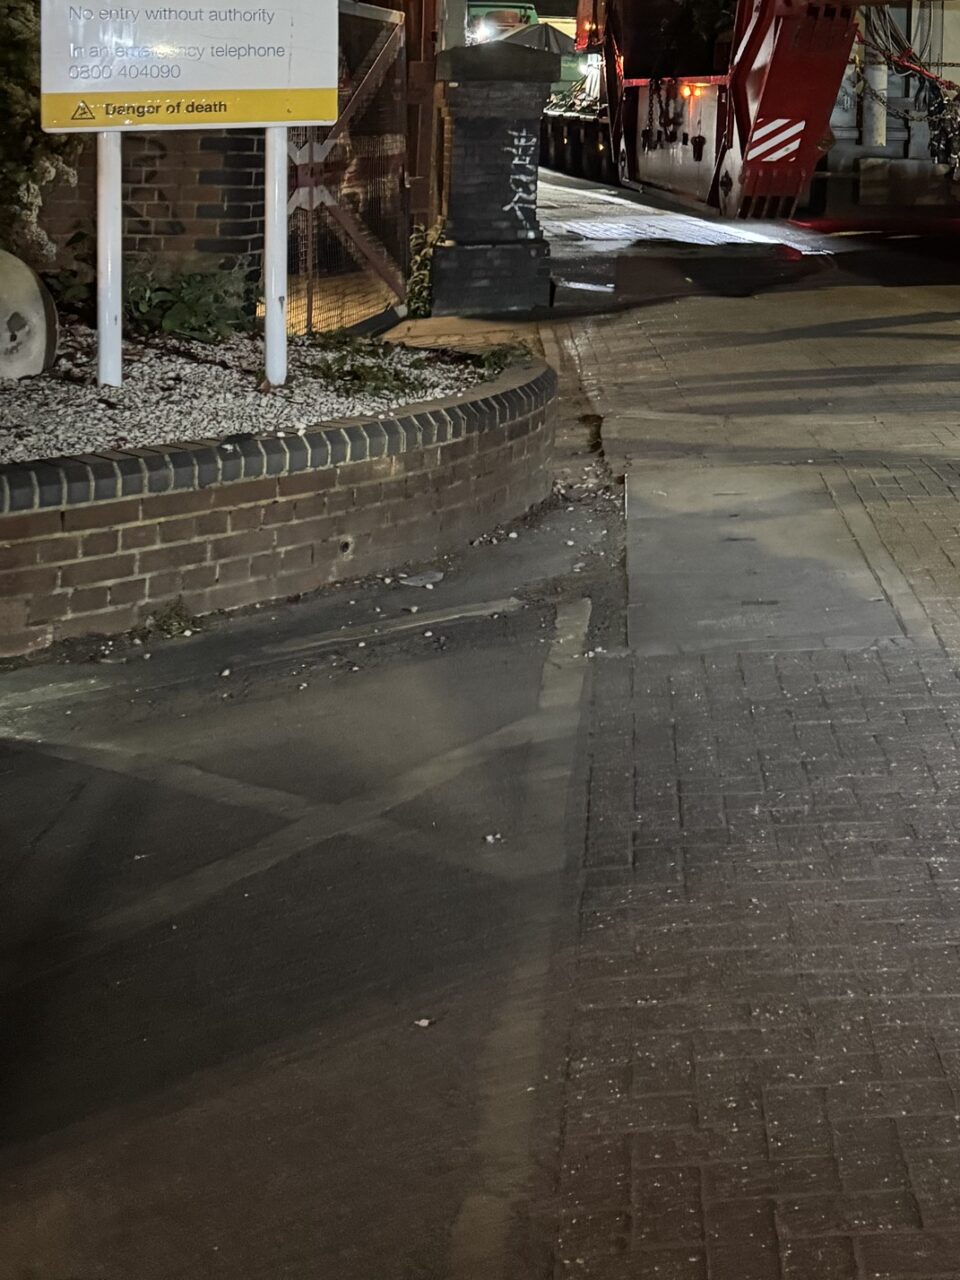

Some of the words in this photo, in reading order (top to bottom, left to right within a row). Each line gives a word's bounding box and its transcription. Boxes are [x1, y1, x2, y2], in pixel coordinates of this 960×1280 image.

[69, 6, 94, 21] No
[99, 7, 139, 24] entry
[145, 6, 204, 22] without
[208, 6, 276, 25] authority
[114, 46, 205, 61] emerncy
[211, 43, 286, 61] telephone
[69, 64, 112, 80] 0800
[118, 64, 181, 80] 404090
[104, 102, 162, 118] Danger
[166, 100, 182, 114] of
[185, 100, 228, 114] death
